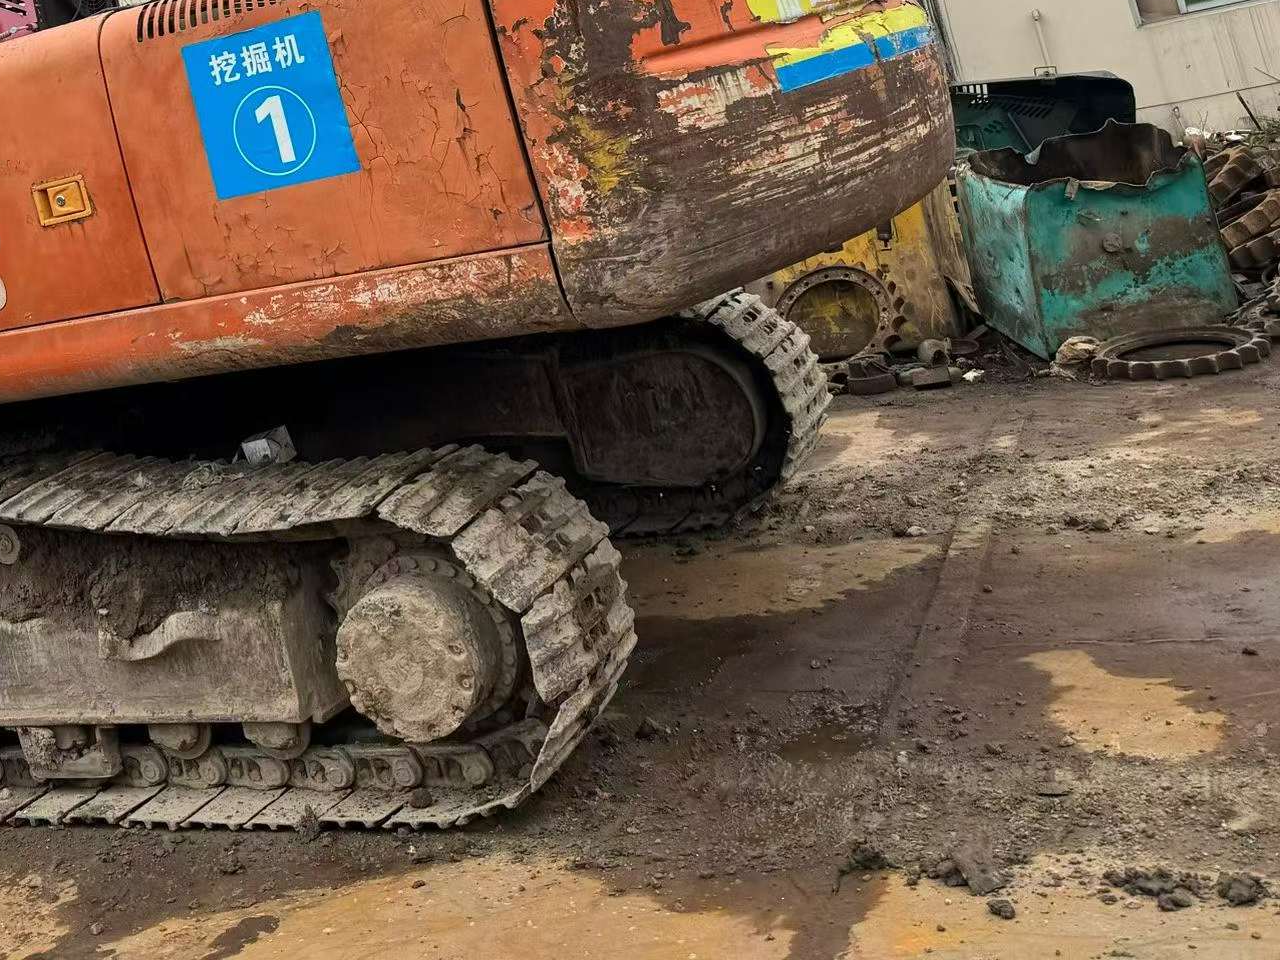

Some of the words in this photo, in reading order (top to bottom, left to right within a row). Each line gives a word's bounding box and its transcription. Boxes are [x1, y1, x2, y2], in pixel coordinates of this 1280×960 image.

[208, 34, 305, 86] 挖掘机
[254, 94, 297, 164] 1
